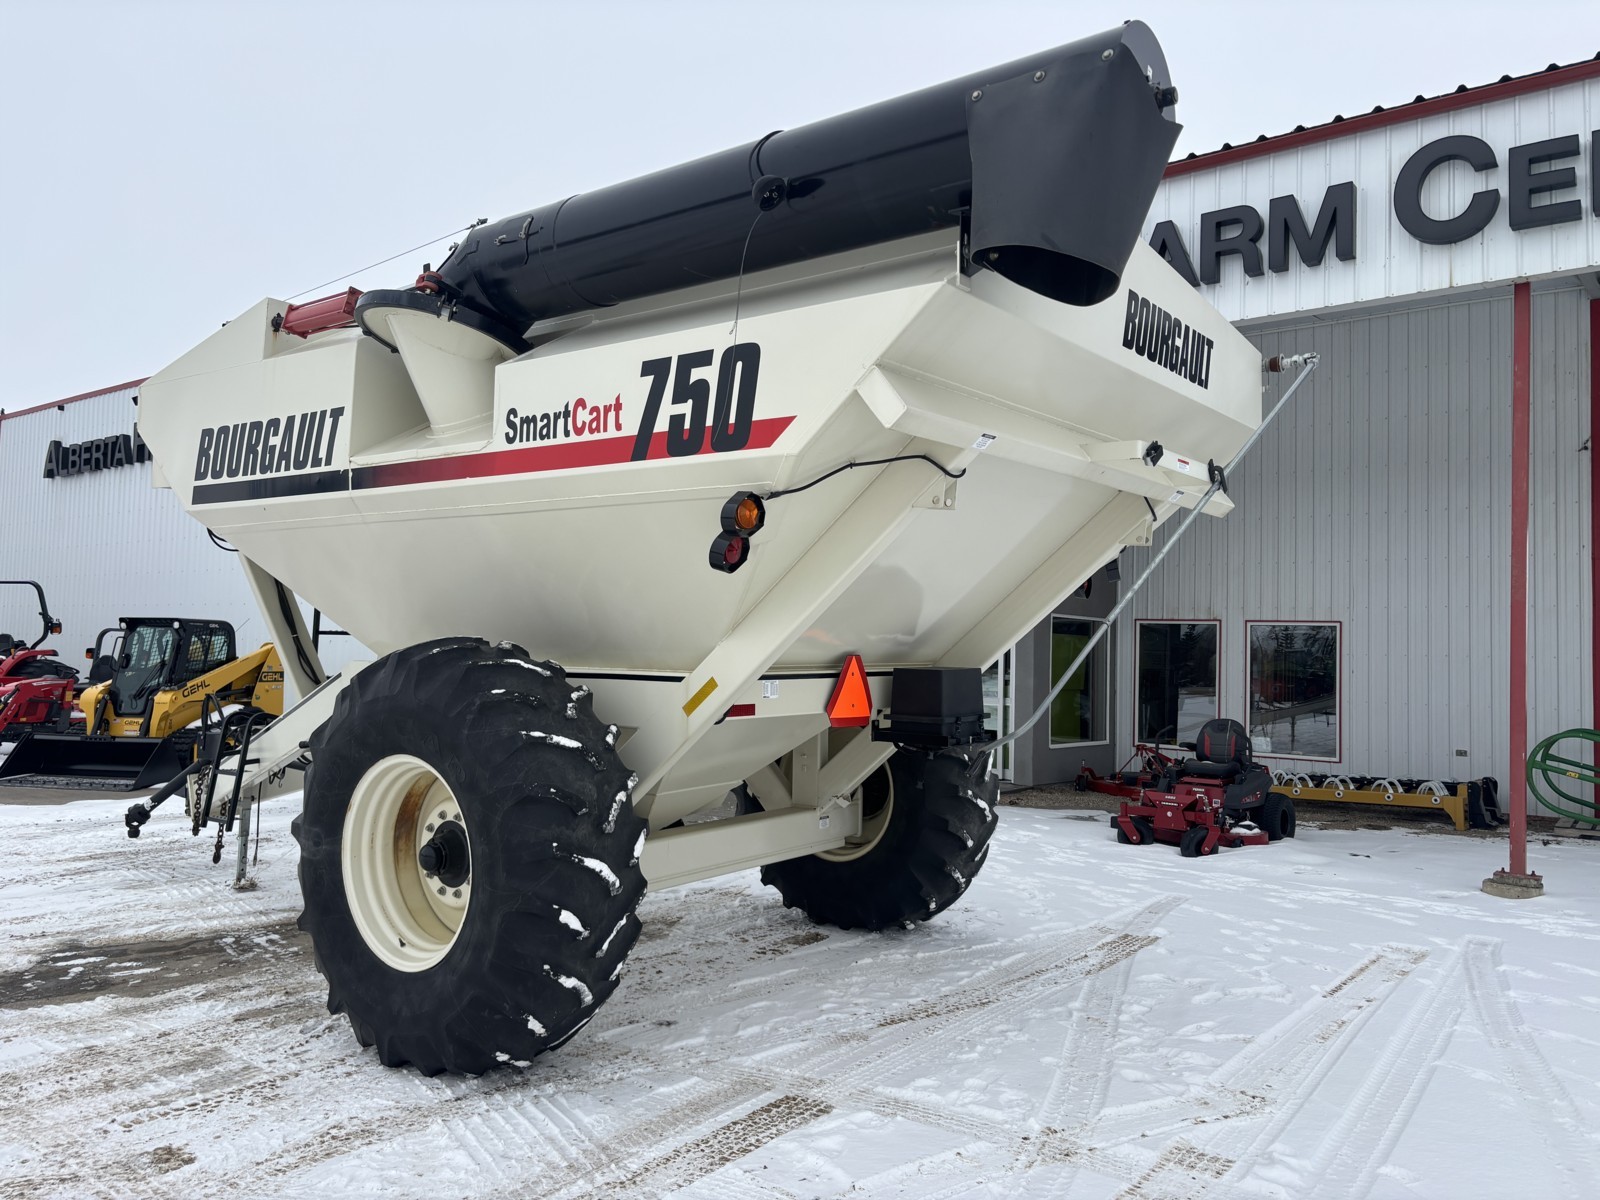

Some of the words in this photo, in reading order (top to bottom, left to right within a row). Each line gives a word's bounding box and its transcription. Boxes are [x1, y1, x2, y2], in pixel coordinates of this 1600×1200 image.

[1149, 181, 1357, 287] ARM
[1393, 129, 1600, 245] CE
[1122, 288, 1214, 390] BOURGAULT
[504, 392, 623, 445] SmartCart
[630, 342, 761, 462] 750
[43, 434, 134, 478] ALBERTA
[194, 406, 345, 482] BOURGAULT
[182, 680, 210, 698] GEHL
[262, 673, 283, 681] GEHL
